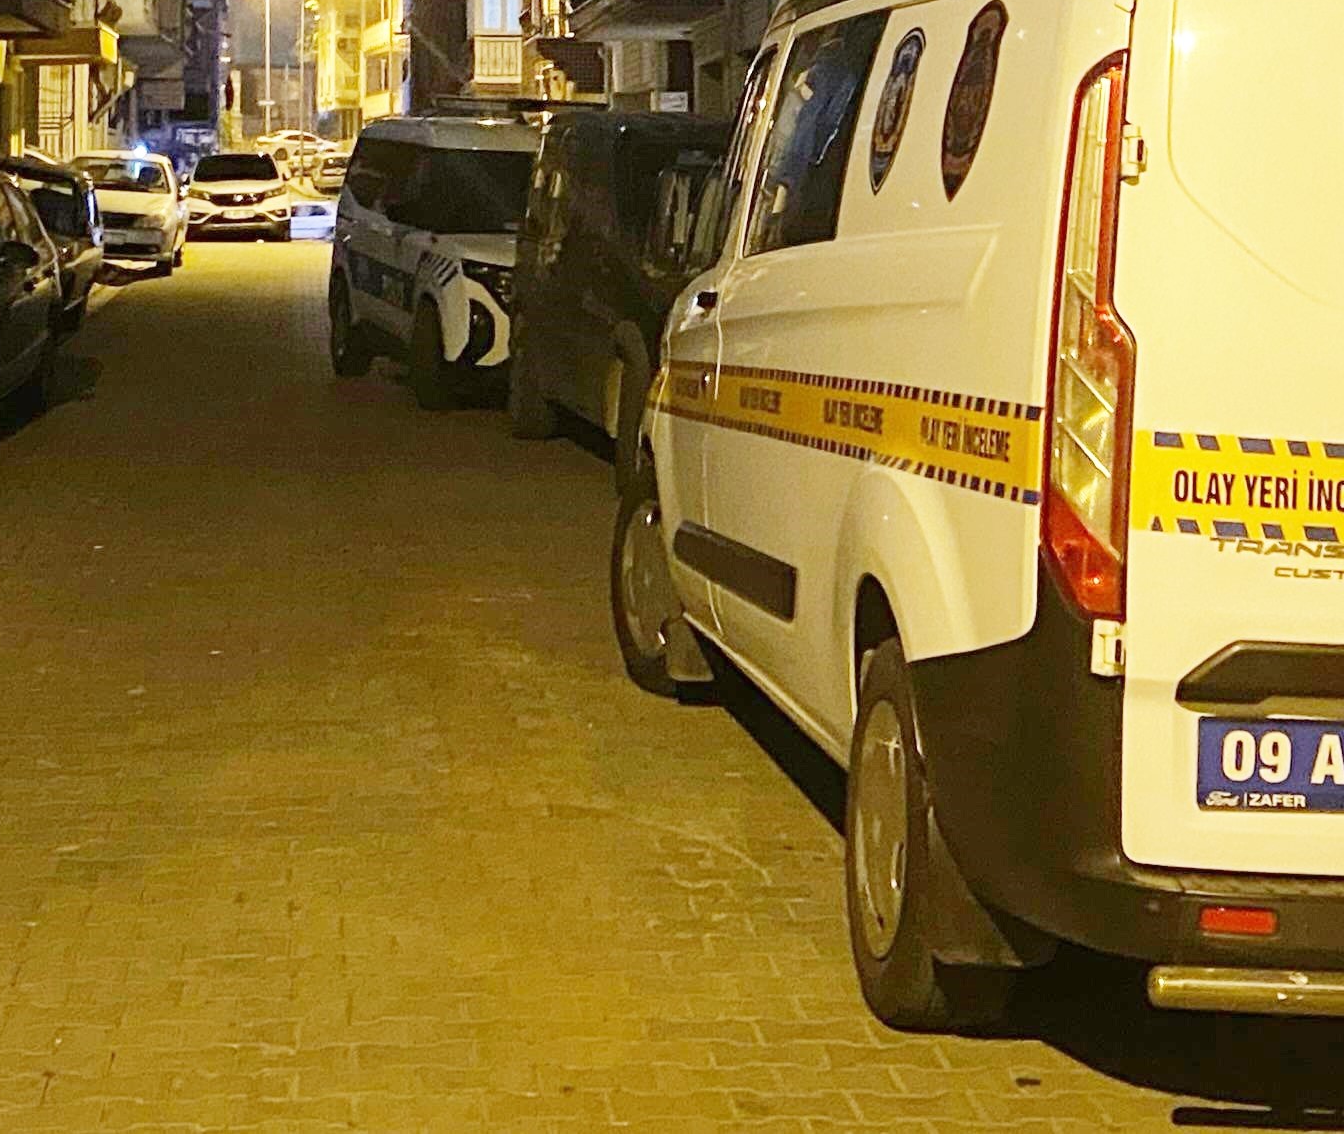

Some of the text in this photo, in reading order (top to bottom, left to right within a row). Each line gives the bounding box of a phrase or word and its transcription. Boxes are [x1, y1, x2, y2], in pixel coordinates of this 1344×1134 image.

[1174, 470, 1236, 505] OLAY
[1245, 469, 1298, 511] YERİ
[1222, 729, 1293, 784] 09
[1248, 792, 1306, 809] ZAFER
